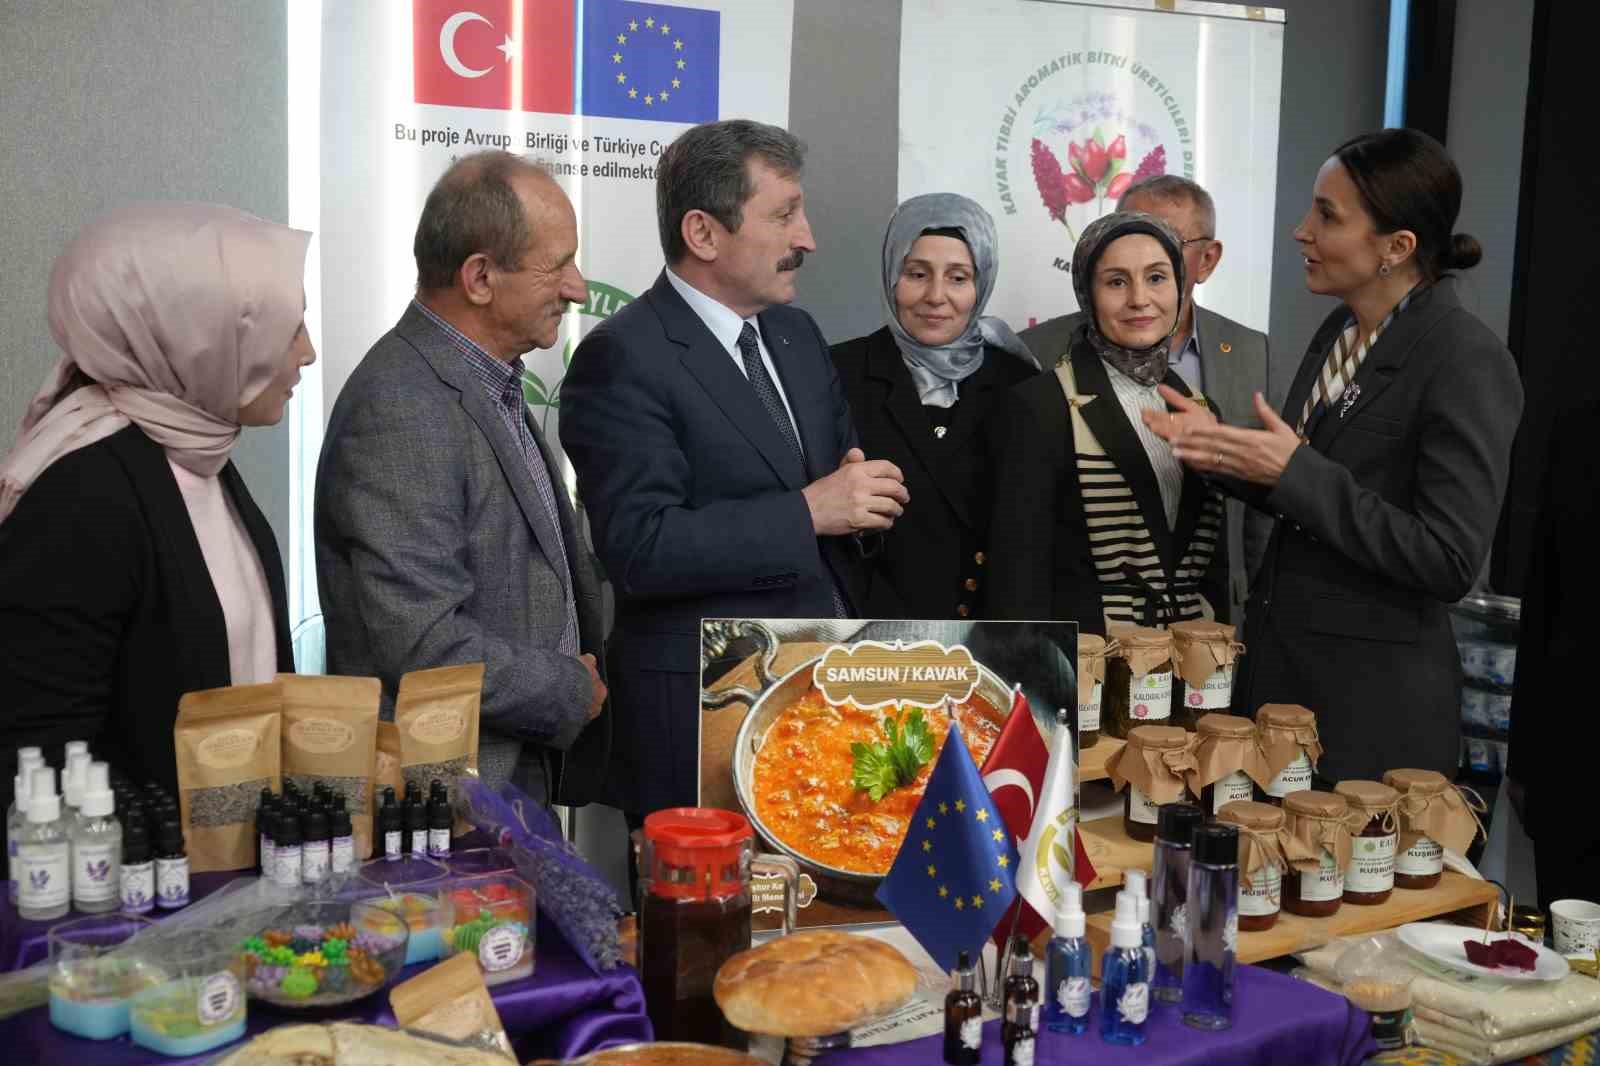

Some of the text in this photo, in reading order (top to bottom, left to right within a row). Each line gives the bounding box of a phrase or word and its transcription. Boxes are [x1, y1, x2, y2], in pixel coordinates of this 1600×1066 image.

[394, 123, 417, 142] Bu
[421, 127, 460, 146] proje
[463, 129, 512, 150] Avrup
[525, 131, 568, 154] Birliği
[571, 139, 590, 152] ve
[594, 136, 647, 159] Türkiye
[996, 156, 1017, 215] KAVAK
[1015, 50, 1083, 107] AROMATİK
[1087, 48, 1127, 68] BİTKİ
[1052, 257, 1071, 273] KA
[827, 666, 969, 683] SAMSUN / KAVAK
